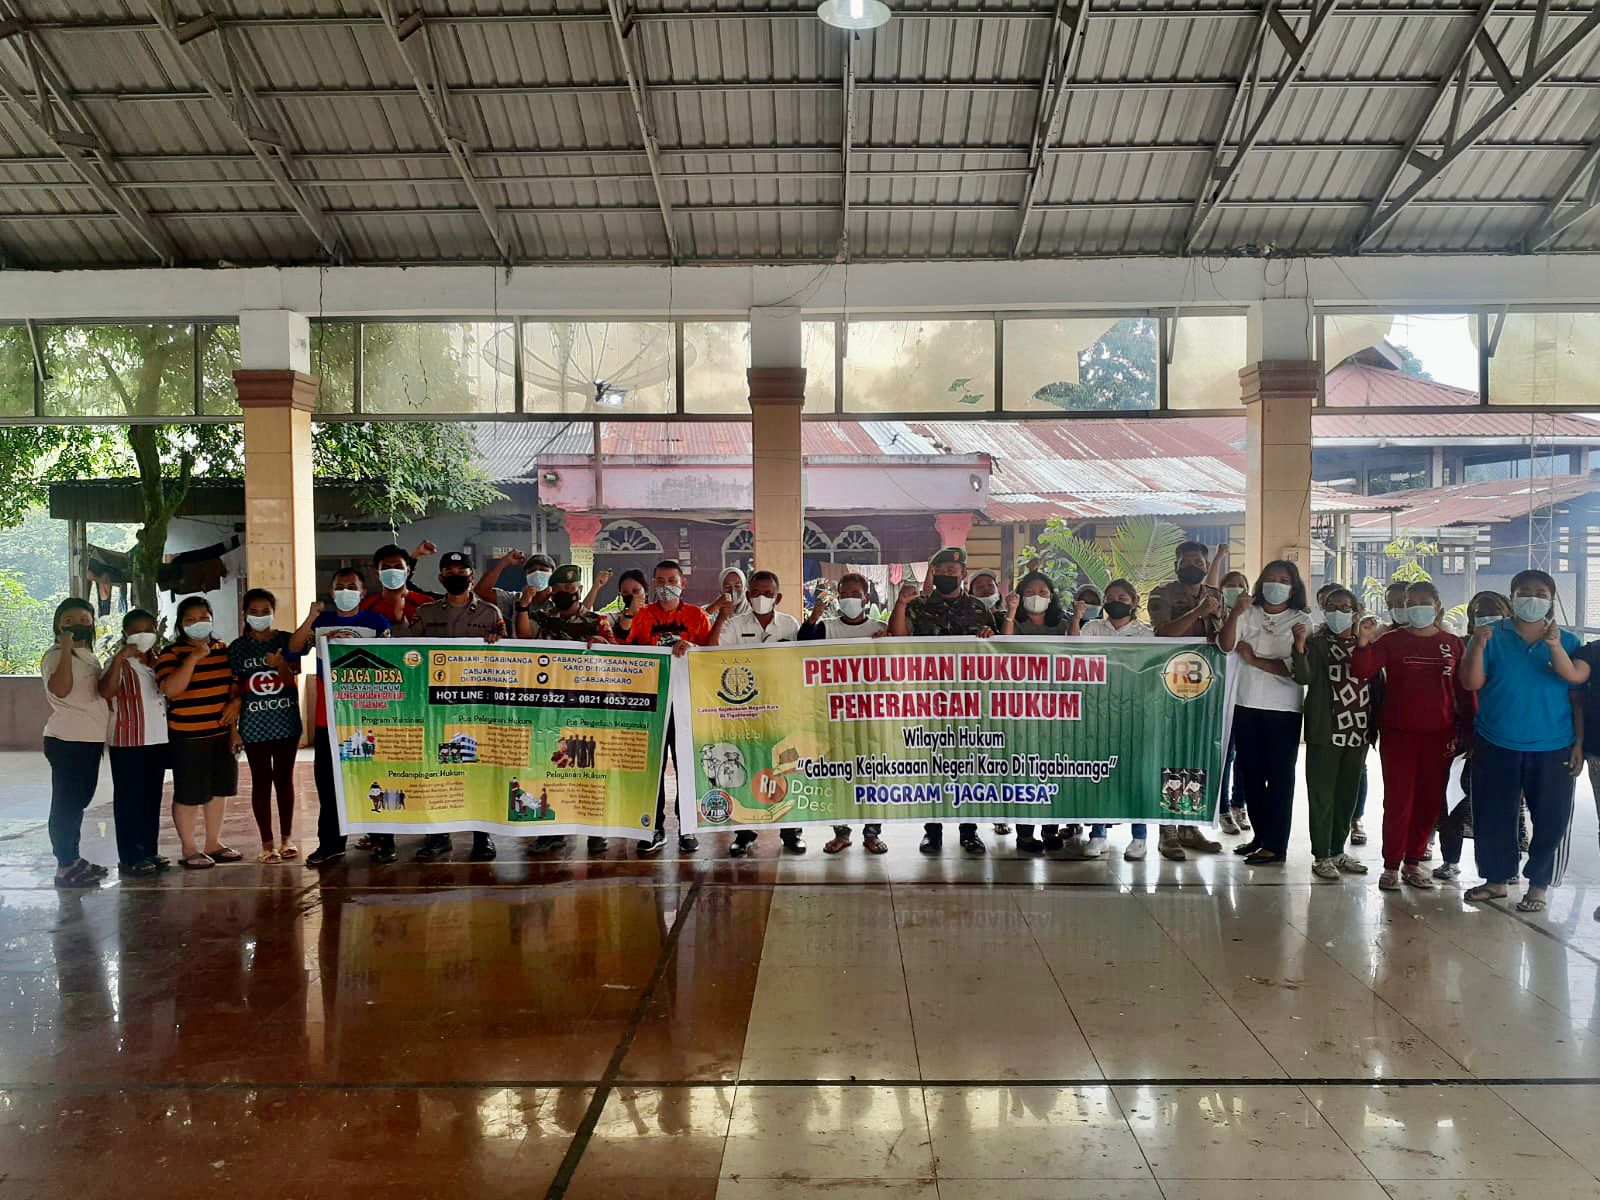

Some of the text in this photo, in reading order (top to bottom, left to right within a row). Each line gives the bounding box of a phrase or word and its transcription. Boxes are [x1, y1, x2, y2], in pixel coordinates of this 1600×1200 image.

[552, 656, 656, 668] CABANG KEJAKSAAN NEGERI
[804, 655, 1105, 685] PENYULUHAN HUKUM DAN
[341, 669, 371, 683] JAGA
[375, 669, 404, 683] DESA
[470, 676, 519, 684] TIGABINANGA
[249, 698, 290, 712] GUCCI
[436, 690, 458, 700] HOT
[460, 690, 484, 700] LINE
[494, 692, 516, 701] 0812
[518, 693, 540, 702] 2687
[542, 693, 565, 703] 9322
[578, 694, 600, 704] 0821
[603, 696, 626, 705] 4053
[627, 697, 650, 706] 2220
[829, 691, 1080, 720] PENERANGAN HUKUM
[903, 726, 1004, 752] Wilayah Hukum
[440, 769, 465, 777] Hukum
[546, 771, 607, 780] Pelayanan Hukum
[856, 754, 928, 781] Kejaksaaan
[932, 754, 974, 779] Negeri
[978, 754, 1008, 775] Karo
[1012, 754, 1025, 774] Di
[760, 775, 777, 798] Rp
[855, 785, 941, 803] PROGRAM
